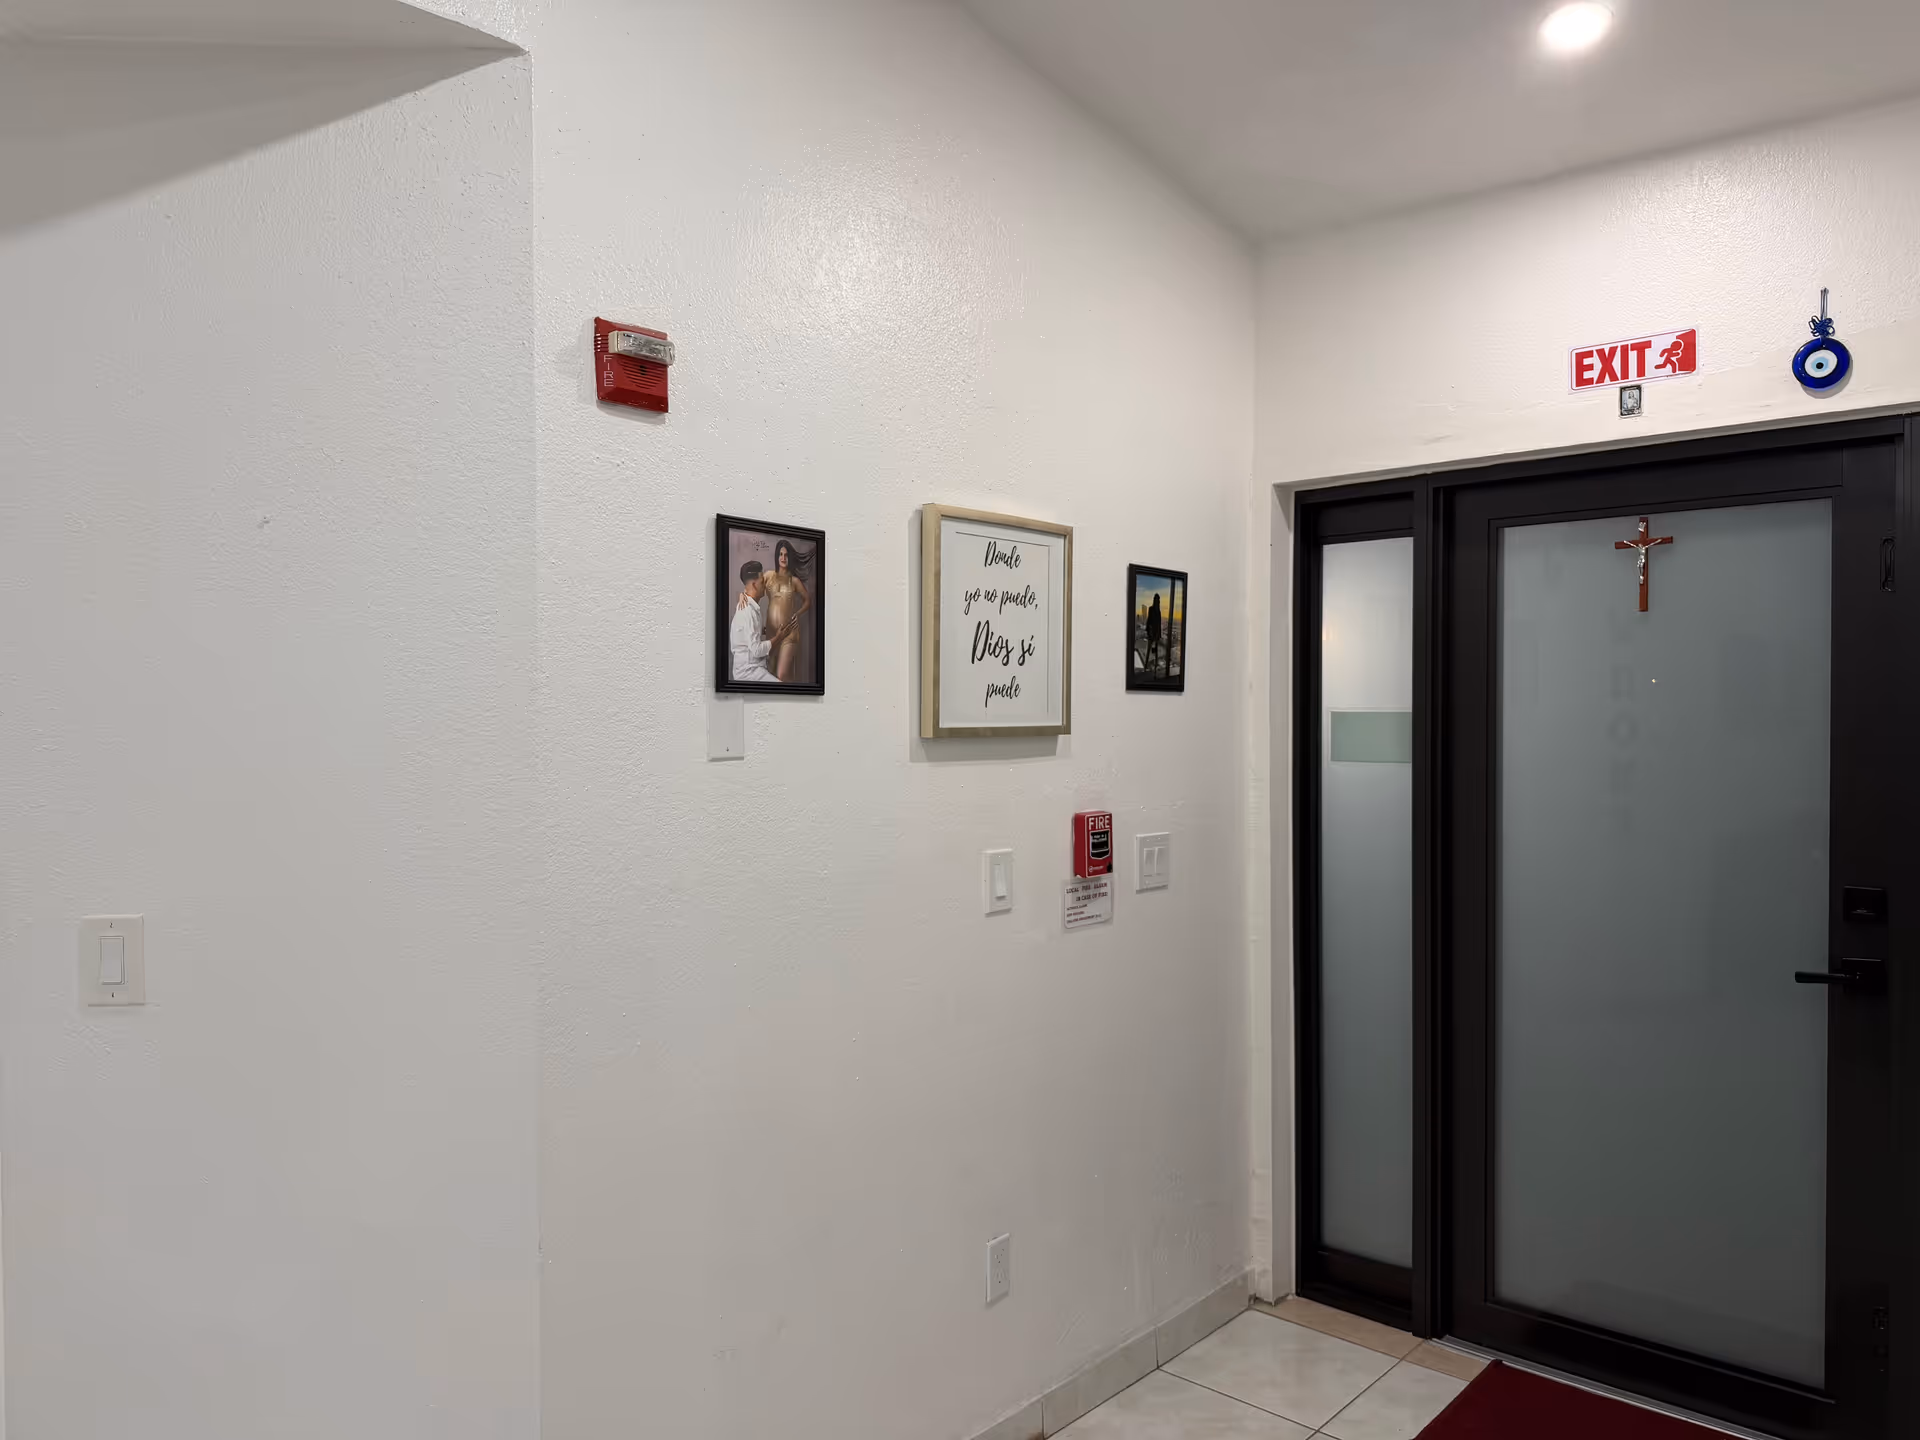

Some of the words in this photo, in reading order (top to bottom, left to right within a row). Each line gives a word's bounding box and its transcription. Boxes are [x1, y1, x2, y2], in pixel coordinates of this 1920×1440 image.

[603, 354, 614, 387] FIRE
[1575, 340, 1652, 387] EXIT
[984, 541, 1021, 569] Donde
[964, 588, 981, 615] yo
[984, 588, 998, 603] no
[1000, 585, 1038, 615] puedo,
[972, 620, 1014, 666] Dios
[1017, 635, 1035, 666] sí
[985, 676, 1021, 708] puede
[1088, 815, 1110, 830] FIRE
